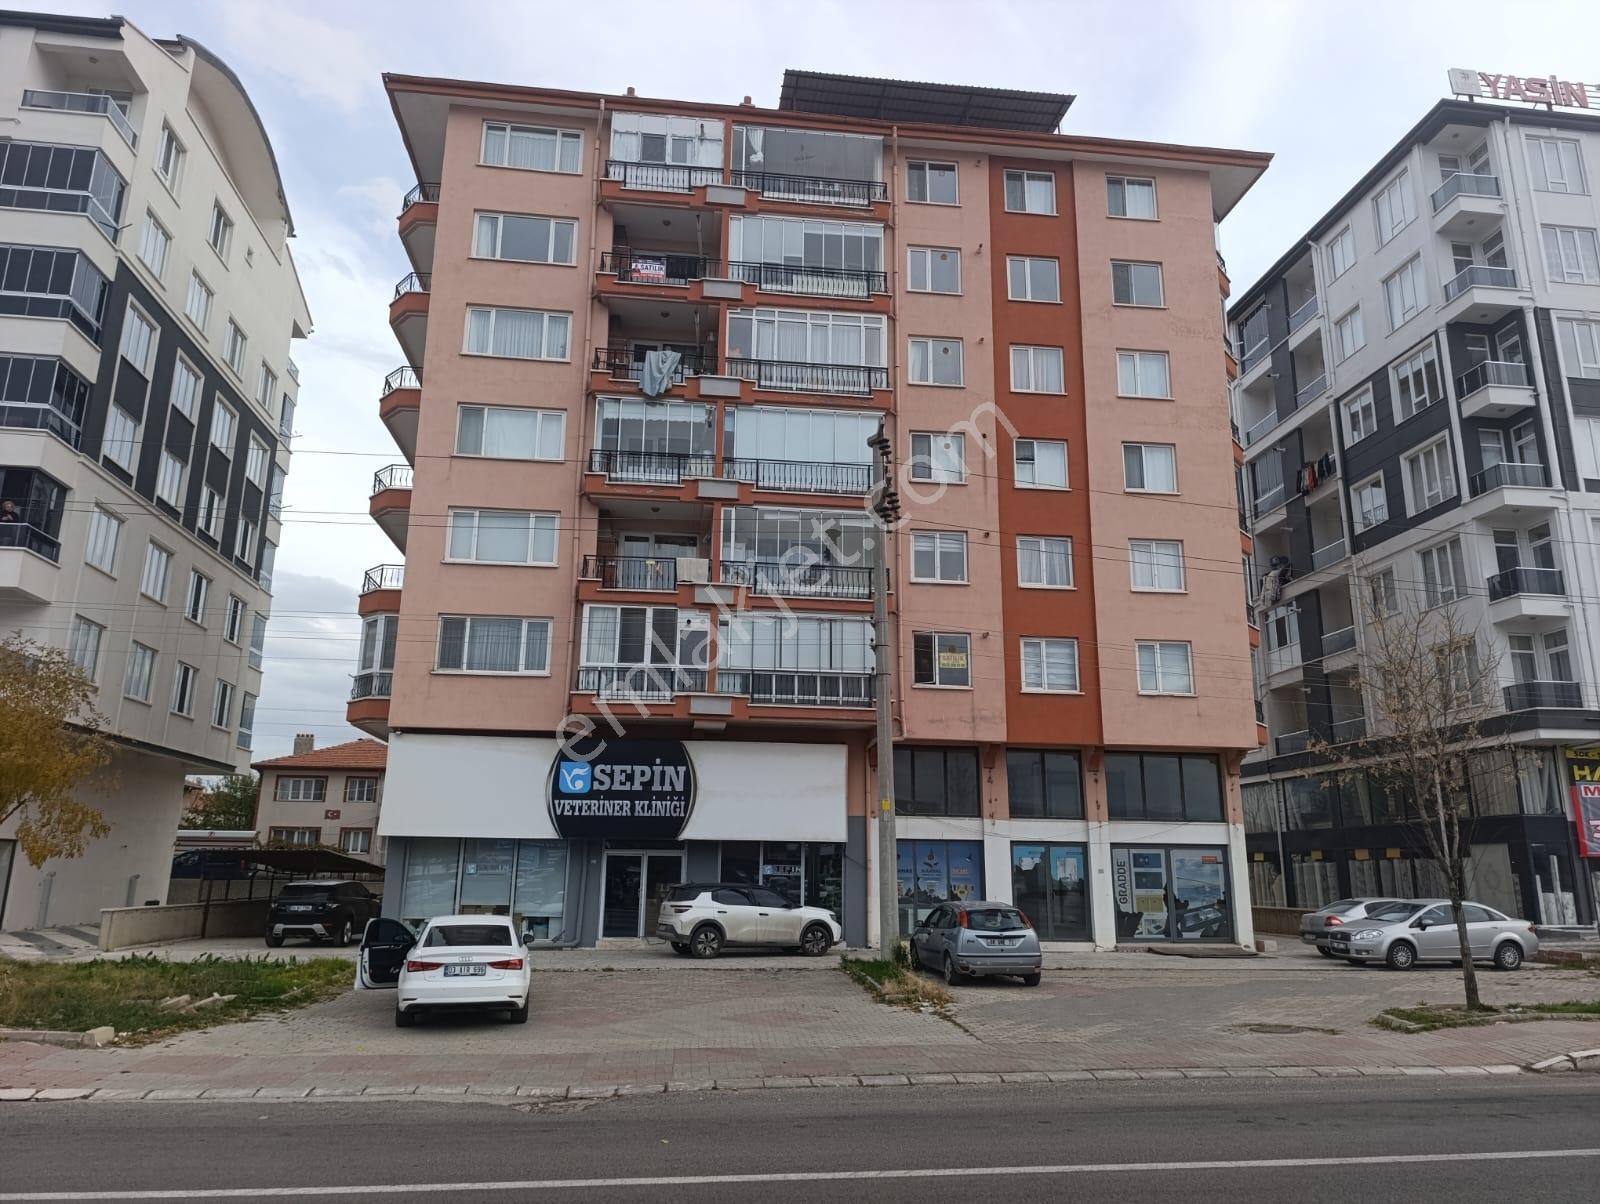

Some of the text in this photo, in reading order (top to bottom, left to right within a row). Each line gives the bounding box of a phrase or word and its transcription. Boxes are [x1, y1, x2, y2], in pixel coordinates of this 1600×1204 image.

[1478, 72, 1589, 108] YASİN
[593, 758, 687, 792] SEPİN
[554, 795, 686, 817] VETERİNER KLİNİĞİ
[1117, 859, 1128, 905] GRADDE
